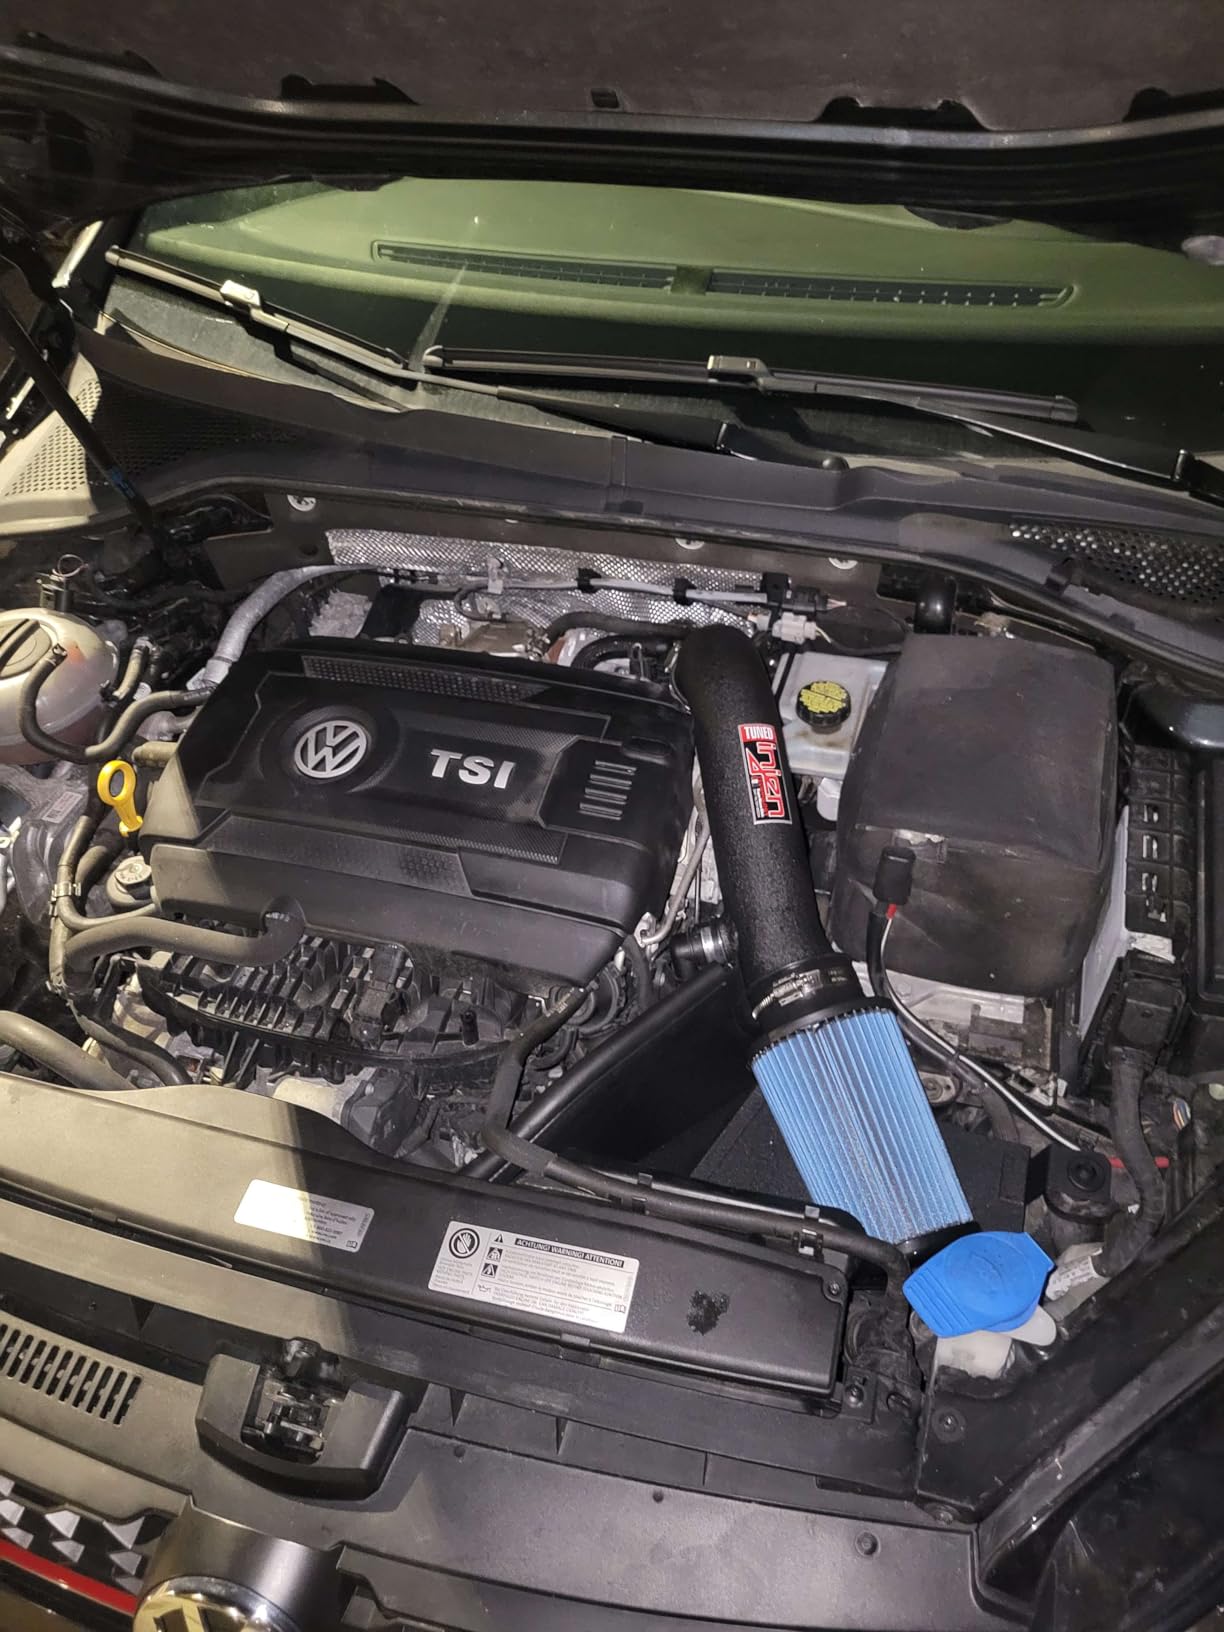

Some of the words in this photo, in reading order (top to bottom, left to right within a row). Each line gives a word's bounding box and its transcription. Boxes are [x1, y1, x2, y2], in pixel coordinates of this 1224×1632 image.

[743, 726, 774, 740] TUNED
[430, 748, 516, 789] TSI
[516, 1239, 551, 1251] ACHTUNG!
[551, 1246, 584, 1258] WARNING!
[585, 1253, 623, 1267] ATTENTION!
